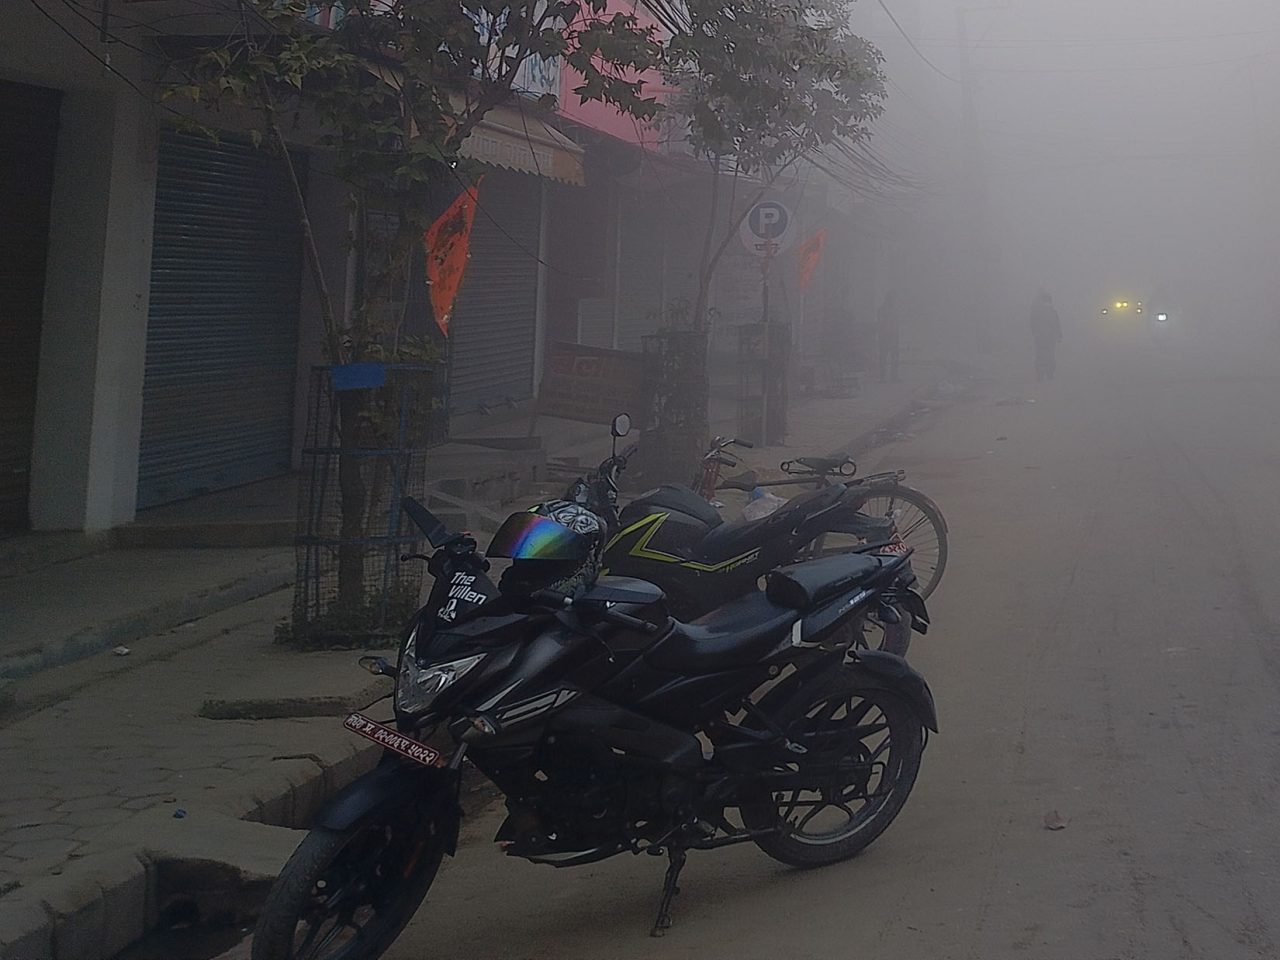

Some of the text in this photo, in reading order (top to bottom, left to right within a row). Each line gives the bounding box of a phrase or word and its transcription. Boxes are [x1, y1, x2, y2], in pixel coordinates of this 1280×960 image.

[759, 207, 780, 234] P
[450, 571, 477, 586] The
[447, 585, 488, 605] Villen
